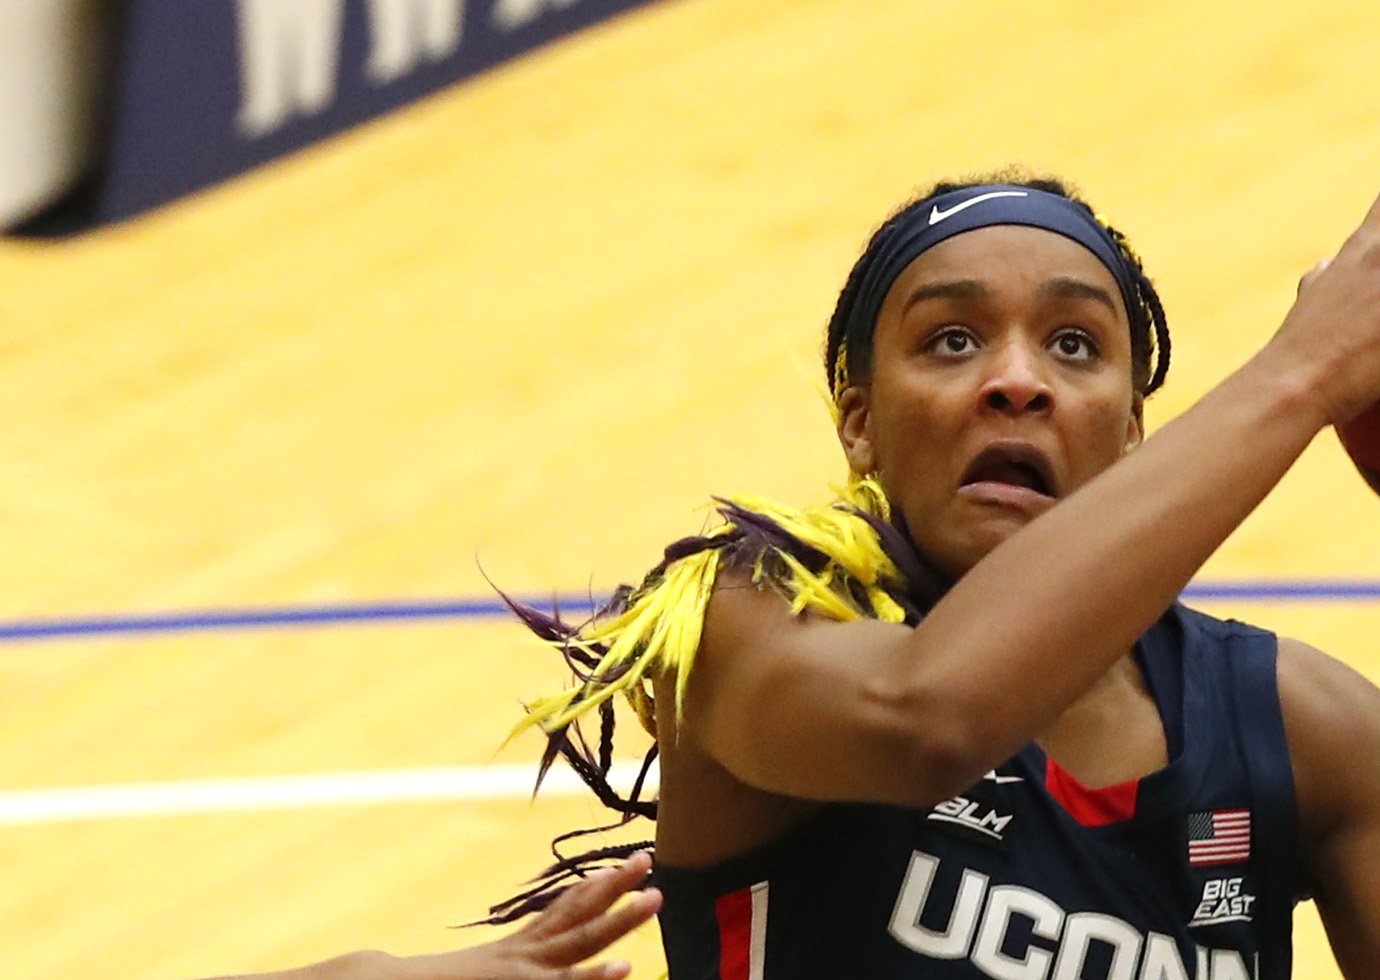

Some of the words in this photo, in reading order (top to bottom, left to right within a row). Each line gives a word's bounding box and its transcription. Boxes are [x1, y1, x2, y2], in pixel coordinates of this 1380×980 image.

[933, 796, 1014, 833] BLM
[1202, 877, 1243, 901] BIG
[1193, 894, 1256, 920] EAST
